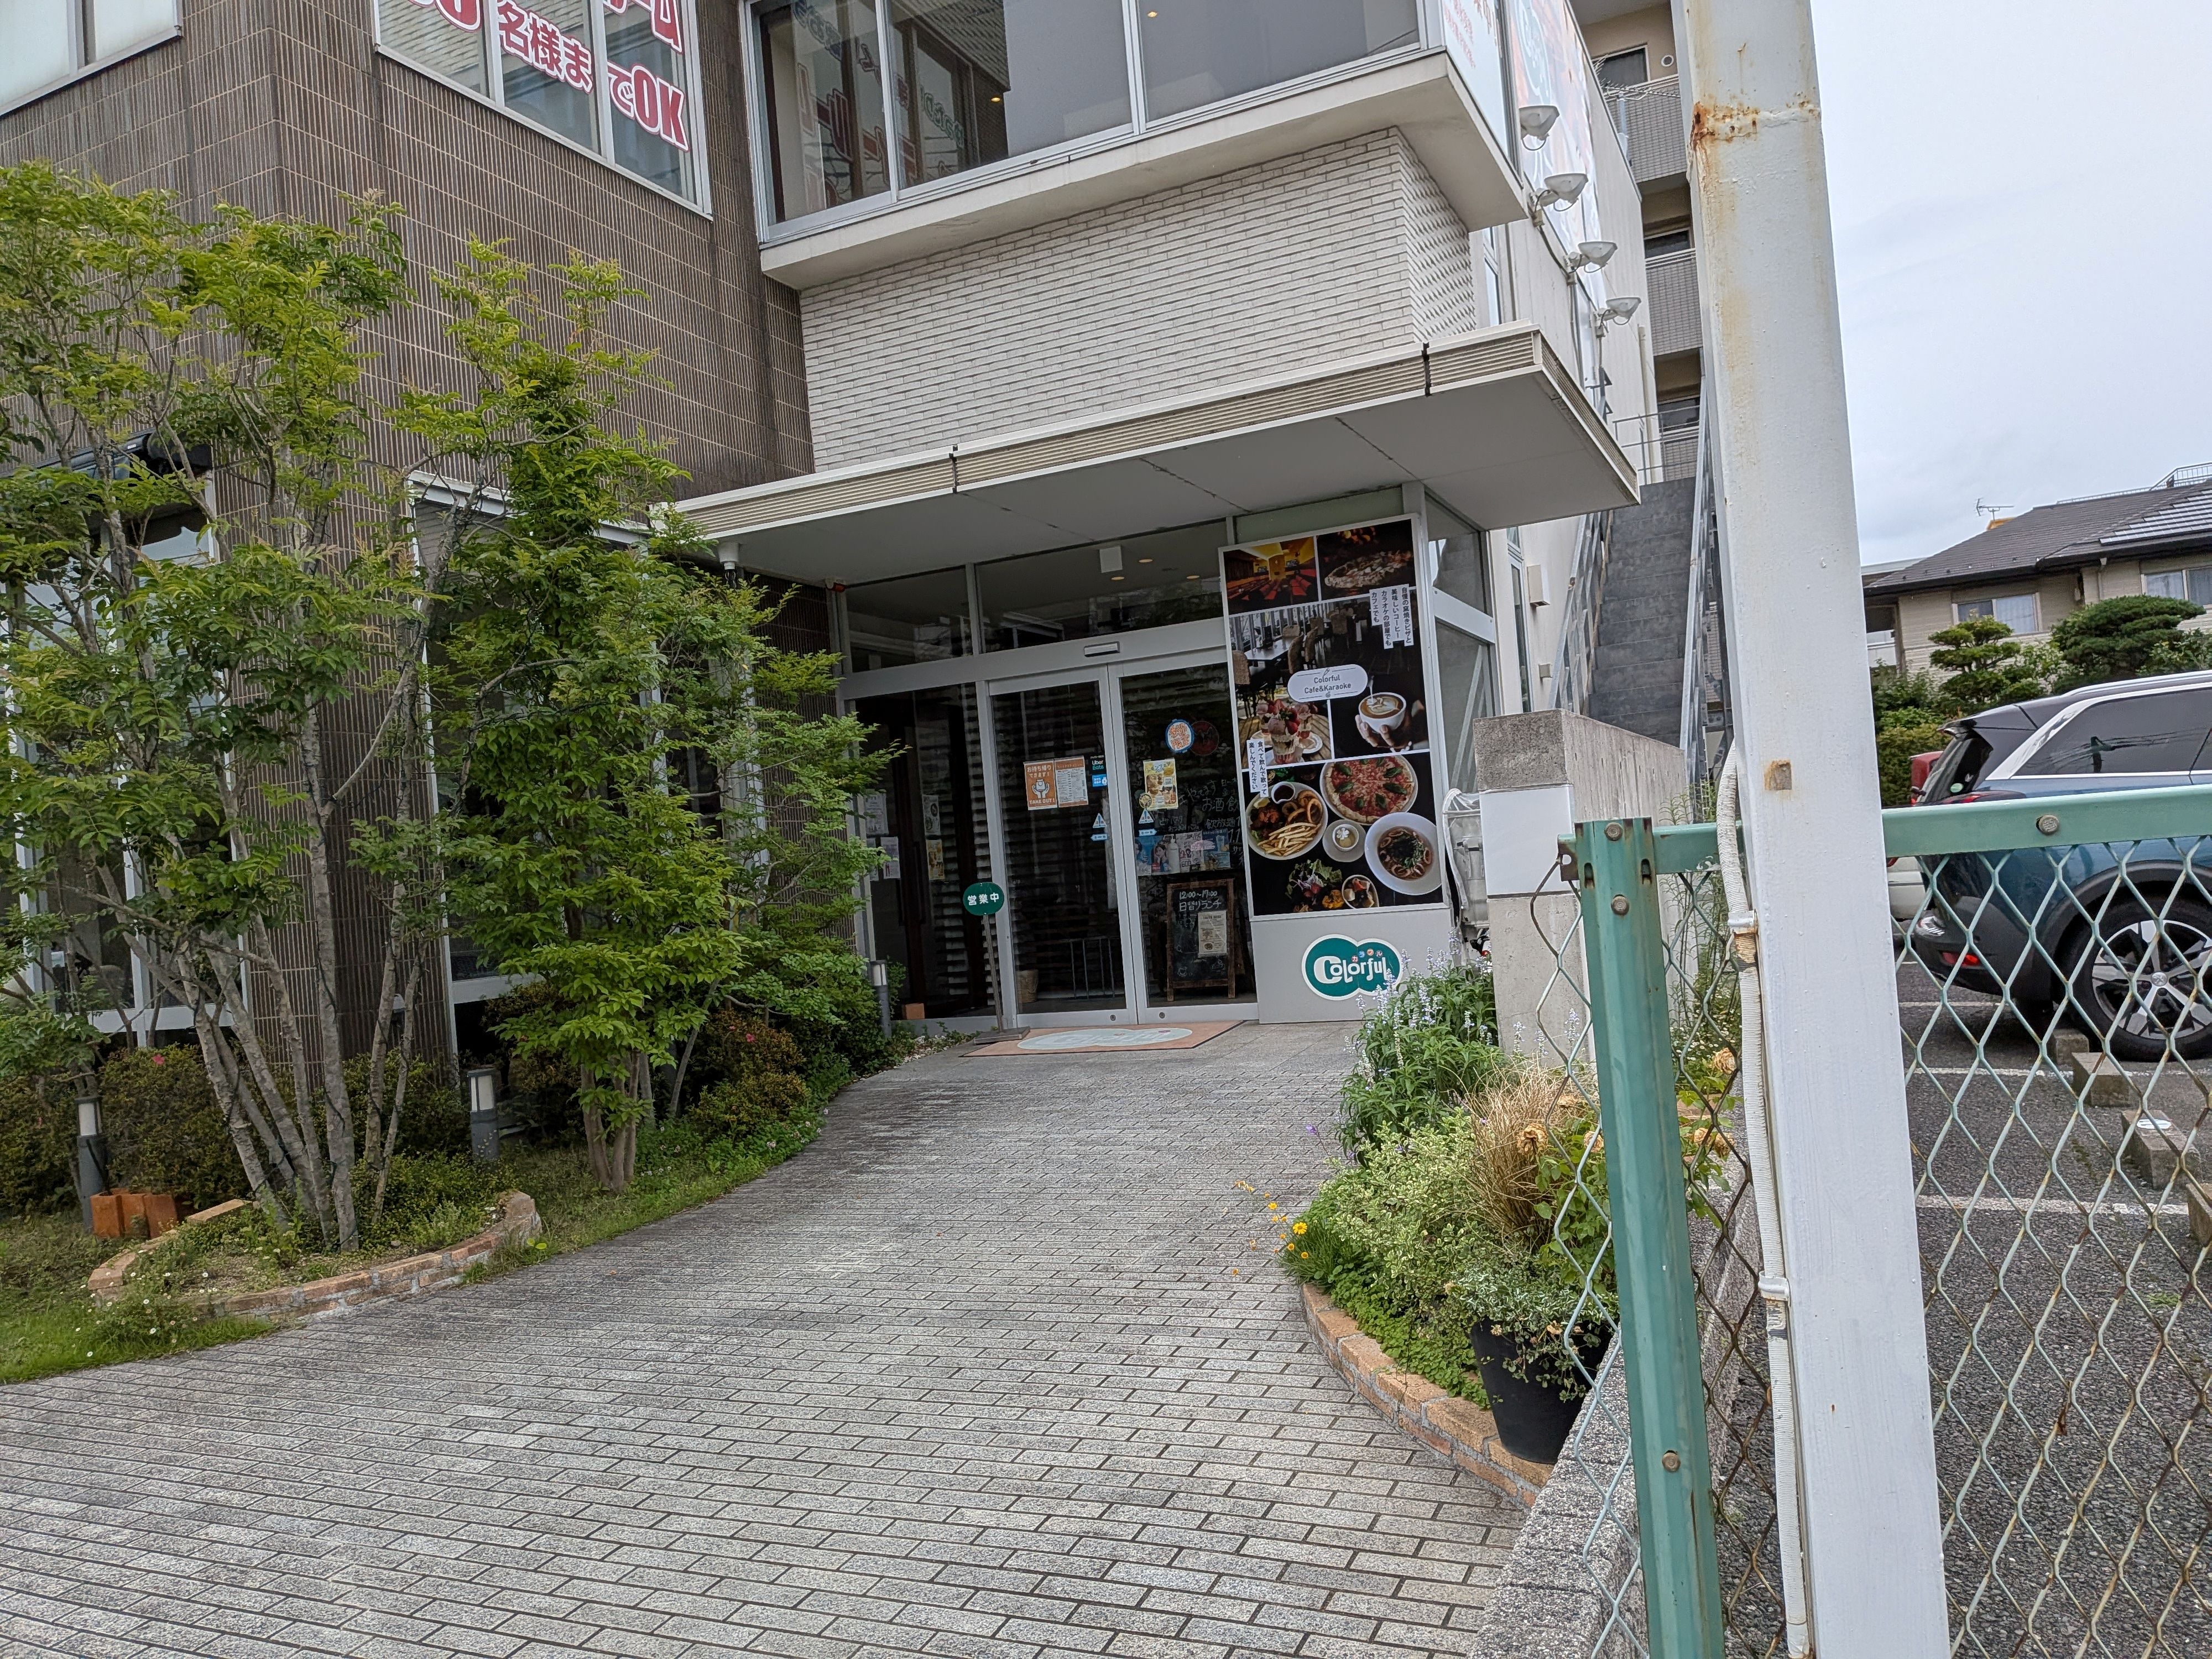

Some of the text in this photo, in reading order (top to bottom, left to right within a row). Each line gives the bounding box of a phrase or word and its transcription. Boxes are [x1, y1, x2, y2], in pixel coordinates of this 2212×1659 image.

[1381, 590, 1391, 646] カラオケの部屋でも
[1391, 588, 1400, 639] 美味しいコーヒー
[1304, 682, 1352, 693] Cafe&Karaoke
[1313, 674, 1340, 684] Colorful
[1249, 742, 1258, 790] 楽しんでください
[1258, 741, 1267, 795] 食べて飲んで歌って
[967, 892, 999, 906] 営業中
[1351, 948, 1383, 963] カラフル
[1313, 956, 1390, 984] Colorful
